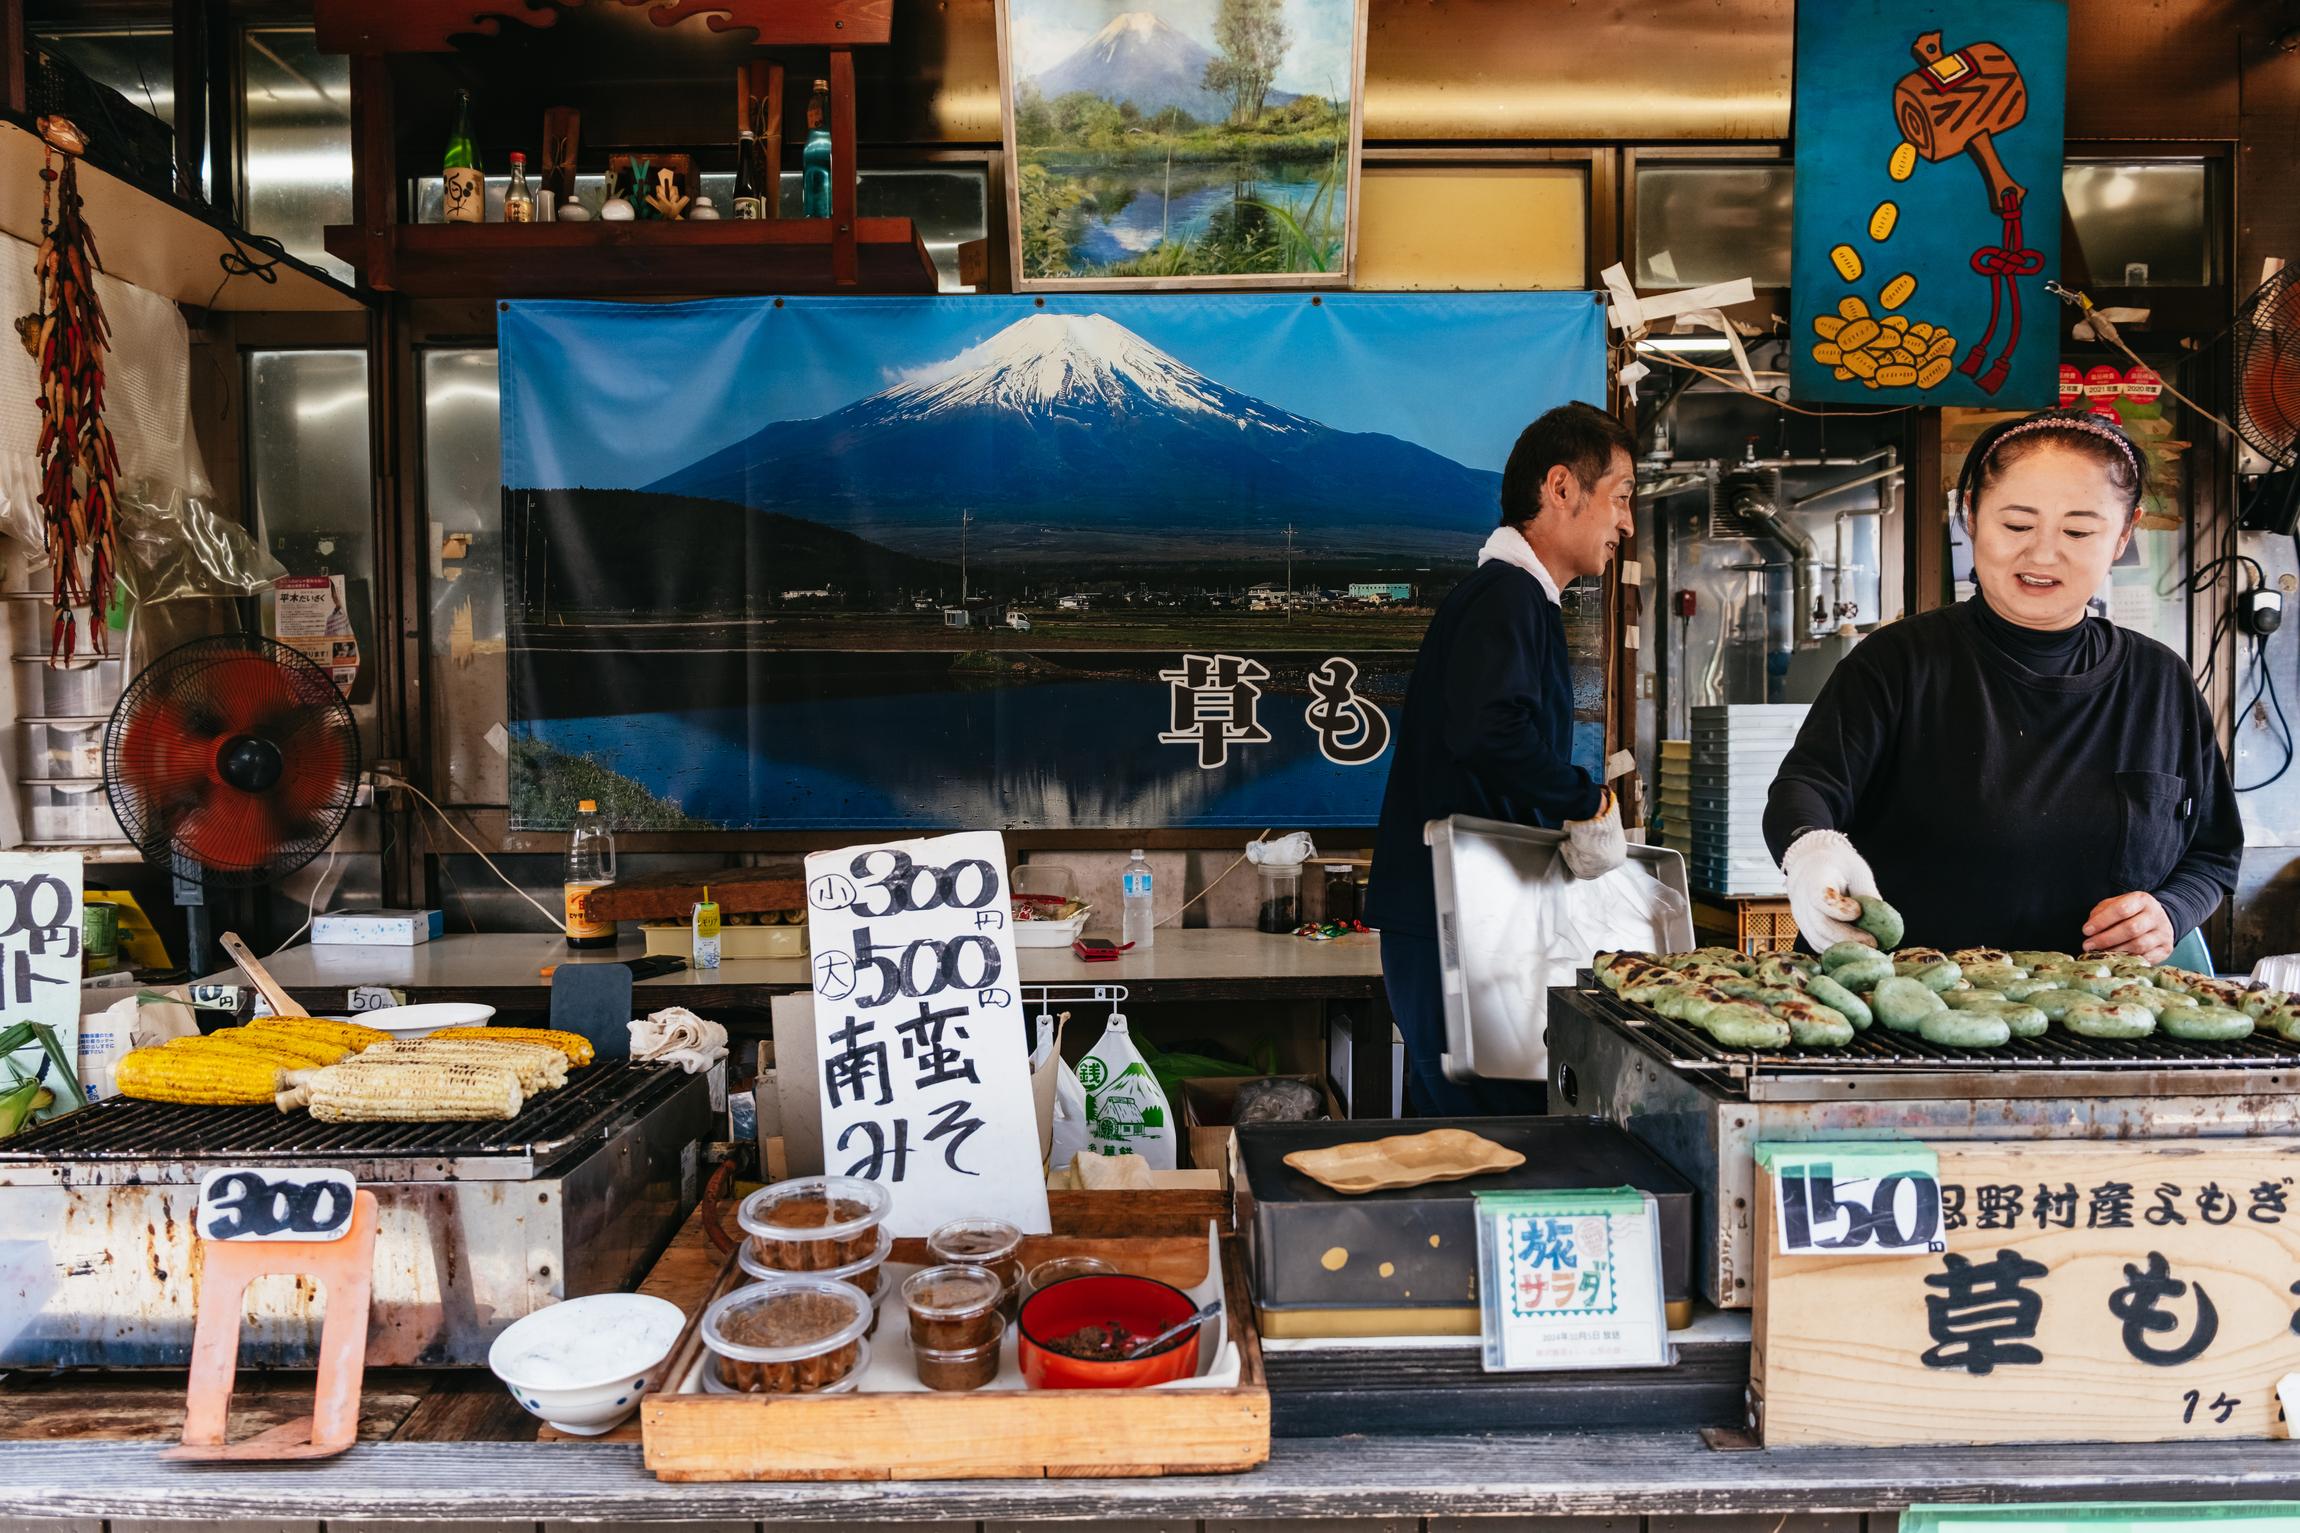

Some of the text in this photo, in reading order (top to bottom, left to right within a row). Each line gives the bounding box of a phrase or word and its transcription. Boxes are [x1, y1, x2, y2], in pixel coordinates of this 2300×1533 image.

[280, 593, 326, 603] 平木だいさく
[824, 1001, 981, 1109] 南蛮
[836, 1099, 987, 1182] みそ
[1519, 1218, 1578, 1271] 旅
[1518, 1260, 1607, 1309] サラダ
